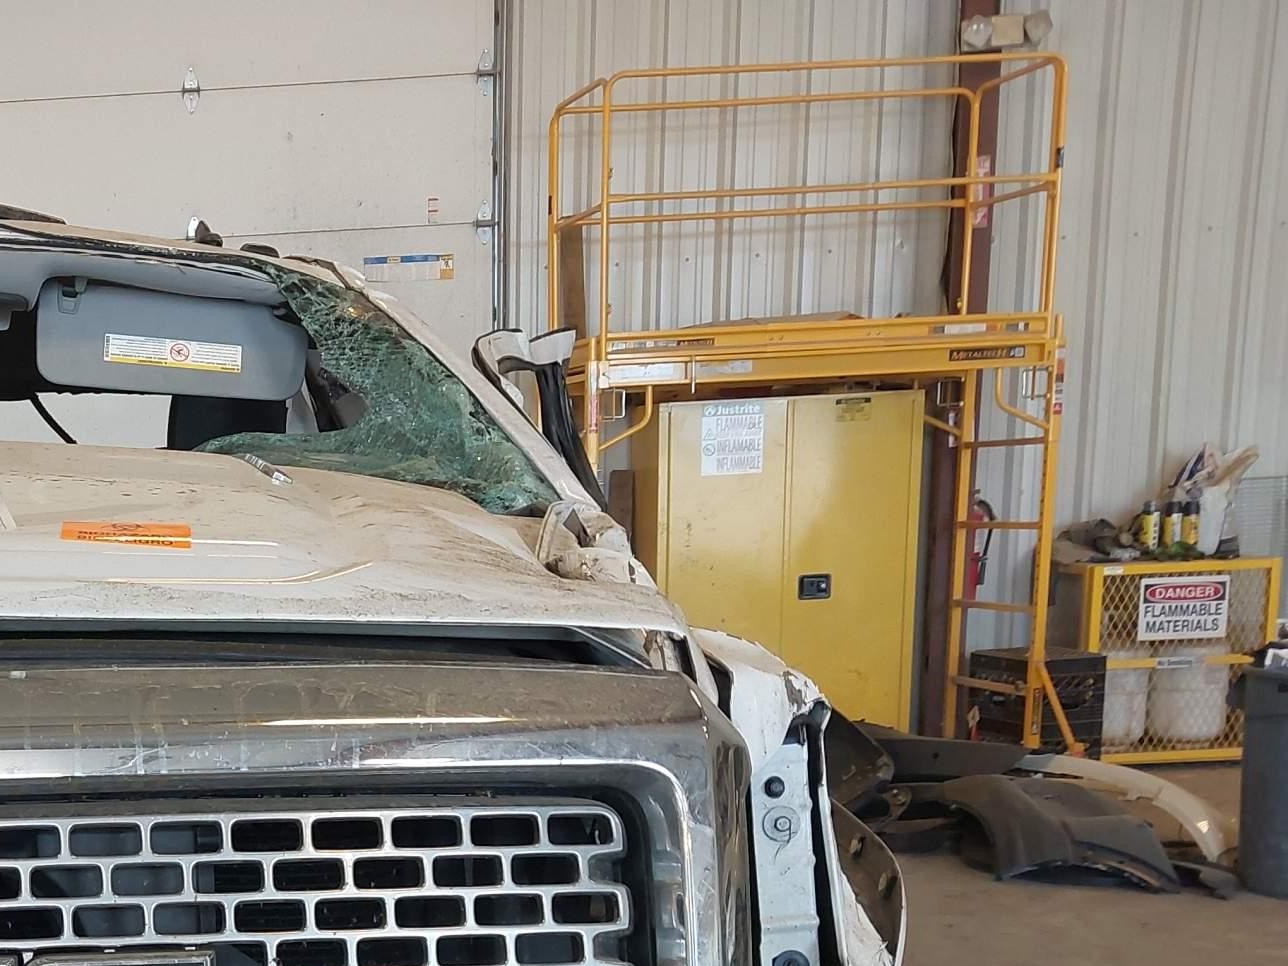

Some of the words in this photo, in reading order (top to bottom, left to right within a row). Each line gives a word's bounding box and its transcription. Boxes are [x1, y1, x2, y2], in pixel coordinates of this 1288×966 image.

[717, 404, 761, 415] Justrite
[716, 415, 762, 432] FLAMMABLE
[1155, 586, 1215, 599] DANGER
[1144, 603, 1223, 618] FLAMMABLE
[1145, 618, 1219, 633] MATERIALS
